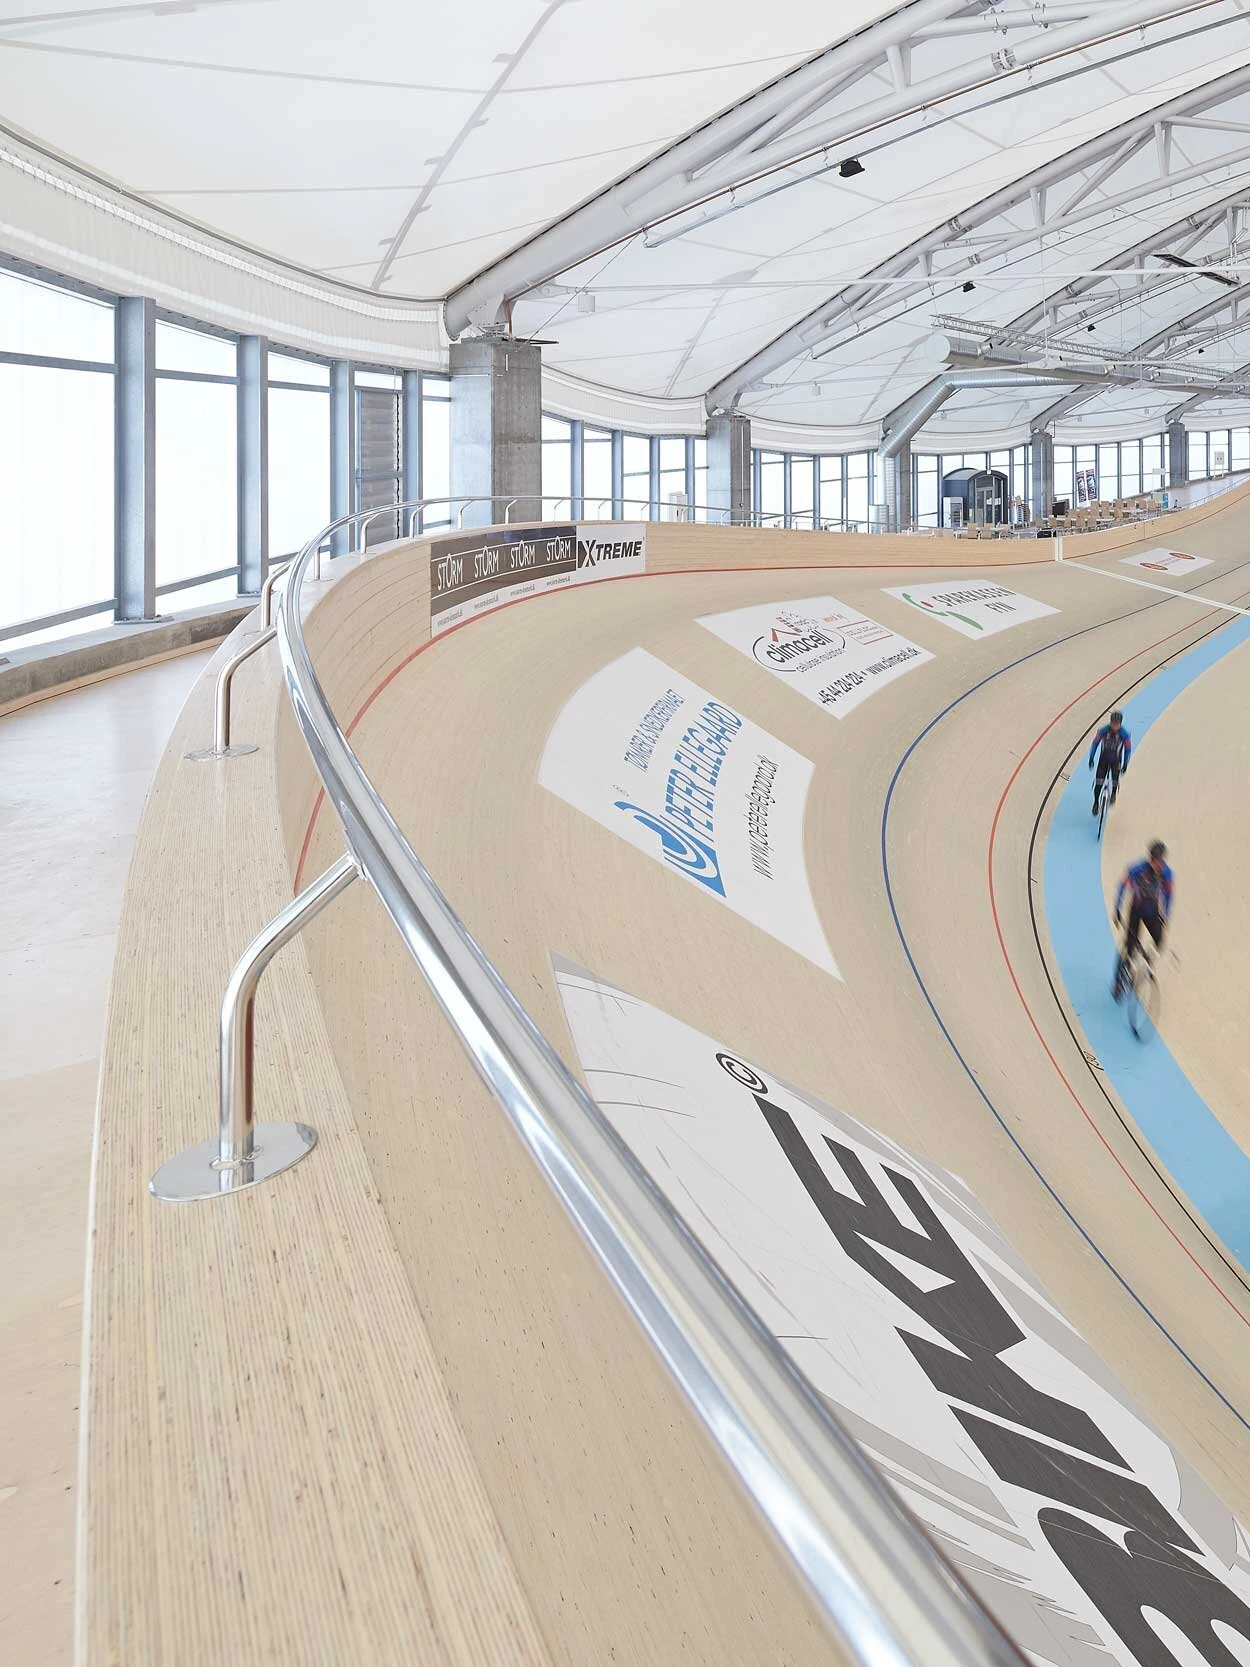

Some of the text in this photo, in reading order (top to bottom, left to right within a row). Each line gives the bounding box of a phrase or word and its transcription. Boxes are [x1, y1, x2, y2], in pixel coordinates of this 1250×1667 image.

[437, 535, 571, 591] STORM STORM STORM STORM
[577, 539, 643, 569] XTREME
[931, 586, 1017, 612] SPAREKASSEN
[765, 629, 833, 664] climacell
[664, 700, 743, 843] PETER ELLEGAARD
